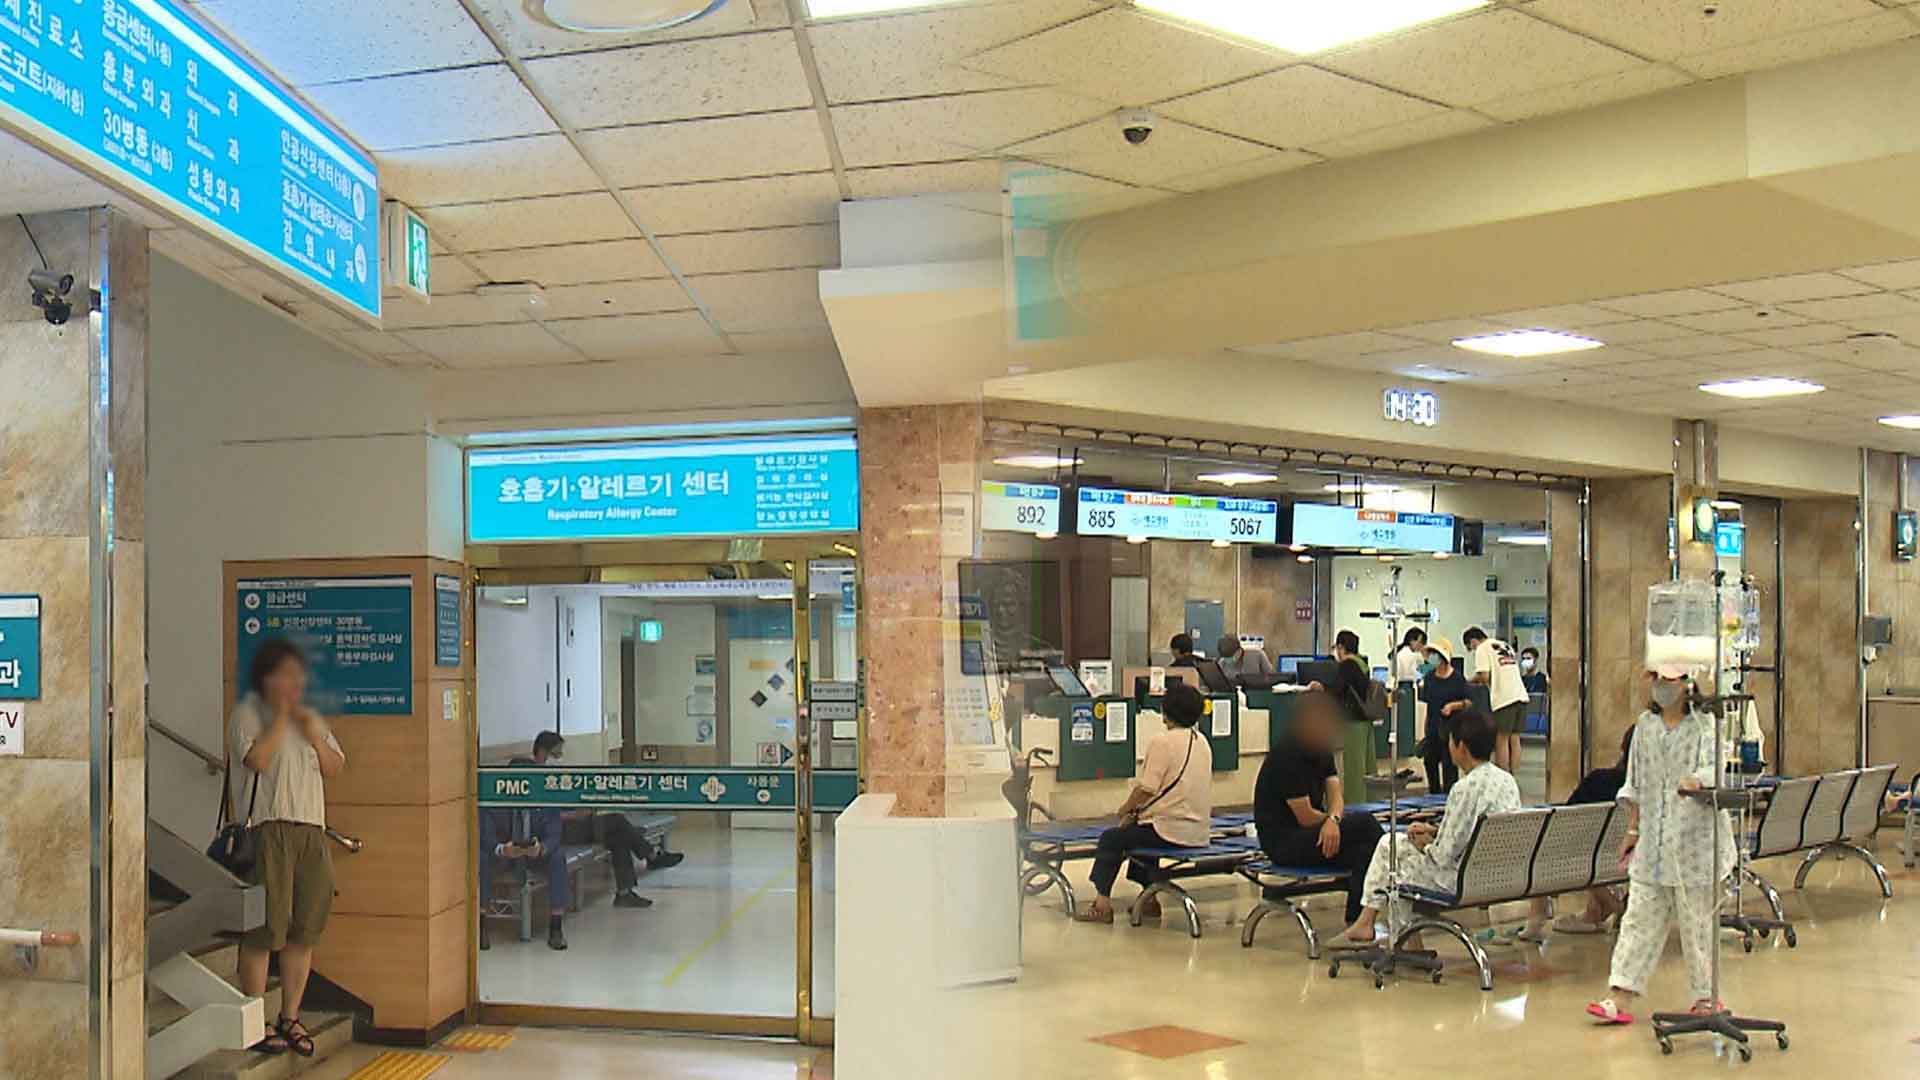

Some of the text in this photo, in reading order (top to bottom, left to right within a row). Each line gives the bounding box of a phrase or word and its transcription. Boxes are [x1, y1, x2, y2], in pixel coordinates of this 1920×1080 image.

[103, 107, 149, 158] 30병동
[187, 159, 240, 214] 성형외과
[498, 468, 729, 503] 호흡기·알레르기 센터
[547, 505, 677, 522] Respiratory Allergy Center
[1017, 505, 1046, 525] 892
[1088, 508, 1116, 528] 885
[1230, 517, 1262, 536] 5067
[496, 779, 530, 795] PMC
[544, 774, 688, 791] 호흡기·알레르기 센터
